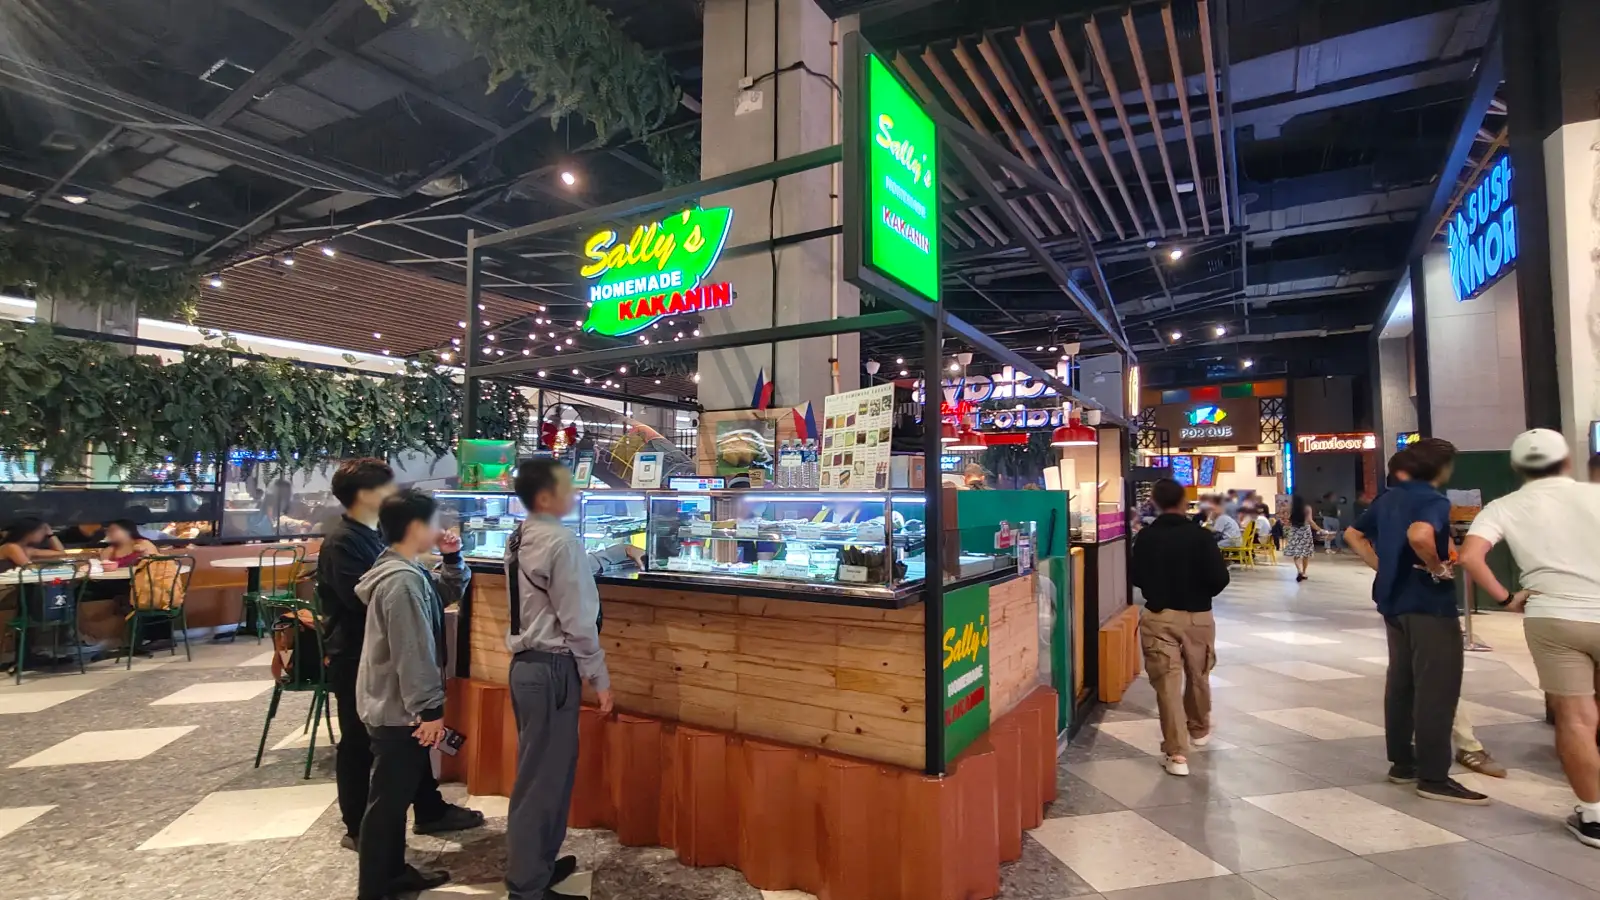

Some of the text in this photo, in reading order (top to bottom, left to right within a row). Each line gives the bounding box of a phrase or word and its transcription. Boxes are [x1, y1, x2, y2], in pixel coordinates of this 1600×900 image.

[876, 113, 932, 188] Sally's
[885, 175, 927, 219] HOMEMADE
[580, 209, 705, 277] Sally's
[882, 205, 930, 254] KAKANIN
[590, 270, 682, 302] HOMEMADE
[617, 282, 733, 321] KAKANIN
[1180, 426, 1233, 438] POR QUE
[1299, 436, 1363, 452] Tandoor
[943, 614, 989, 670] Sally's
